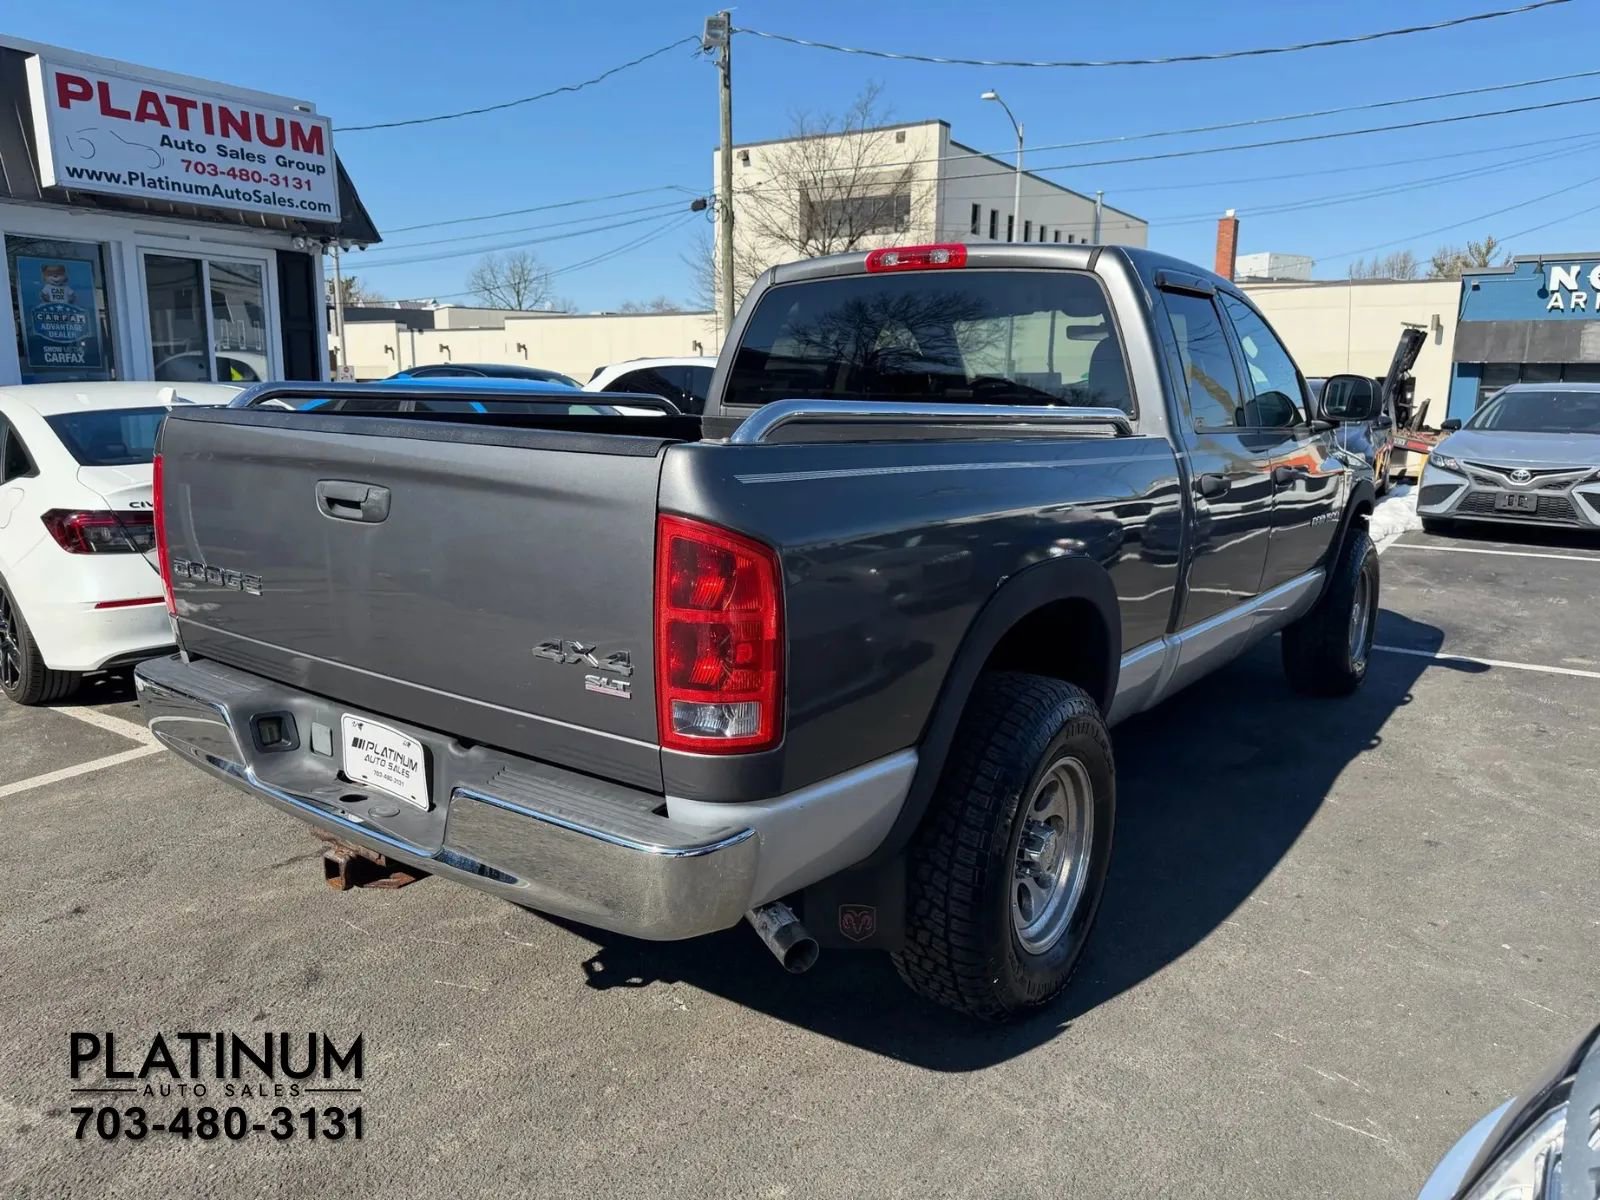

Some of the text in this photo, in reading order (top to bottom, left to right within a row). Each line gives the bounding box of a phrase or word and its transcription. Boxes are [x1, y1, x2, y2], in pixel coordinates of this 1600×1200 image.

[55, 72, 325, 156] PLATINUM
[160, 134, 327, 175] Auto Sales Group
[65, 165, 331, 213] www.PlatinumAutoSales.com
[181, 159, 313, 191] 703-480-3131
[44, 353, 86, 363] CARFAX
[173, 557, 263, 597] DODGE
[584, 674, 631, 692] SLT
[364, 754, 410, 779] AUTO SALES
[365, 741, 418, 773] PLATINUM
